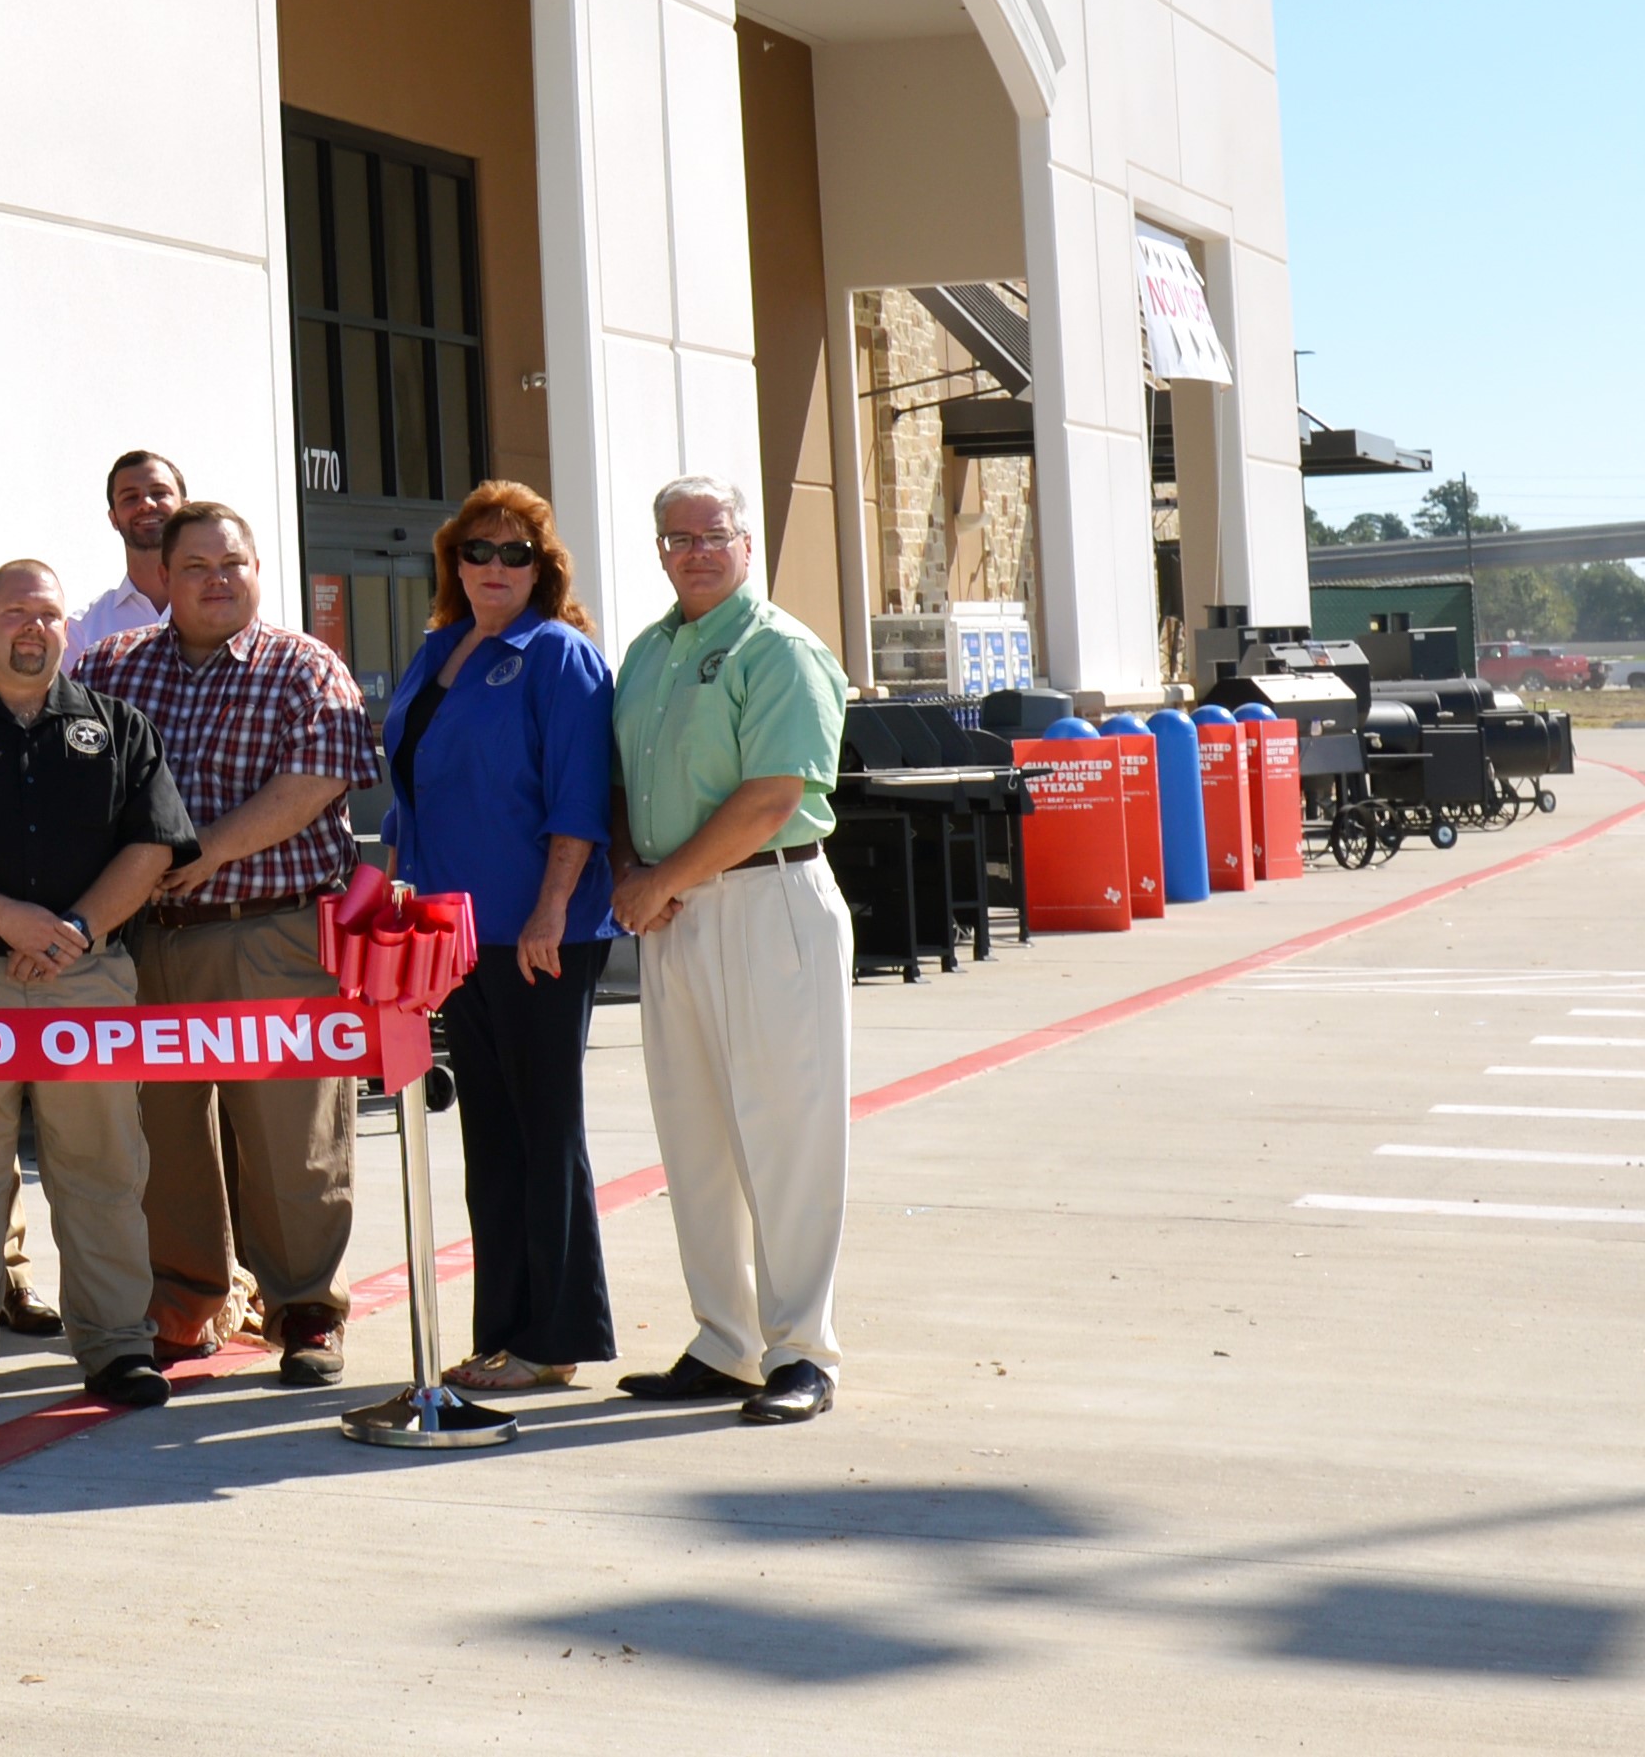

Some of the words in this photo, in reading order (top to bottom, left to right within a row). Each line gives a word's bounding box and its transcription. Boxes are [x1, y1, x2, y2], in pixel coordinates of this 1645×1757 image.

[1145, 275, 1188, 318] NOW
[304, 447, 341, 493] 1770
[1042, 782, 1085, 793] TEXAS
[1058, 771, 1102, 782] PRICES
[41, 1012, 367, 1066] OPENING
